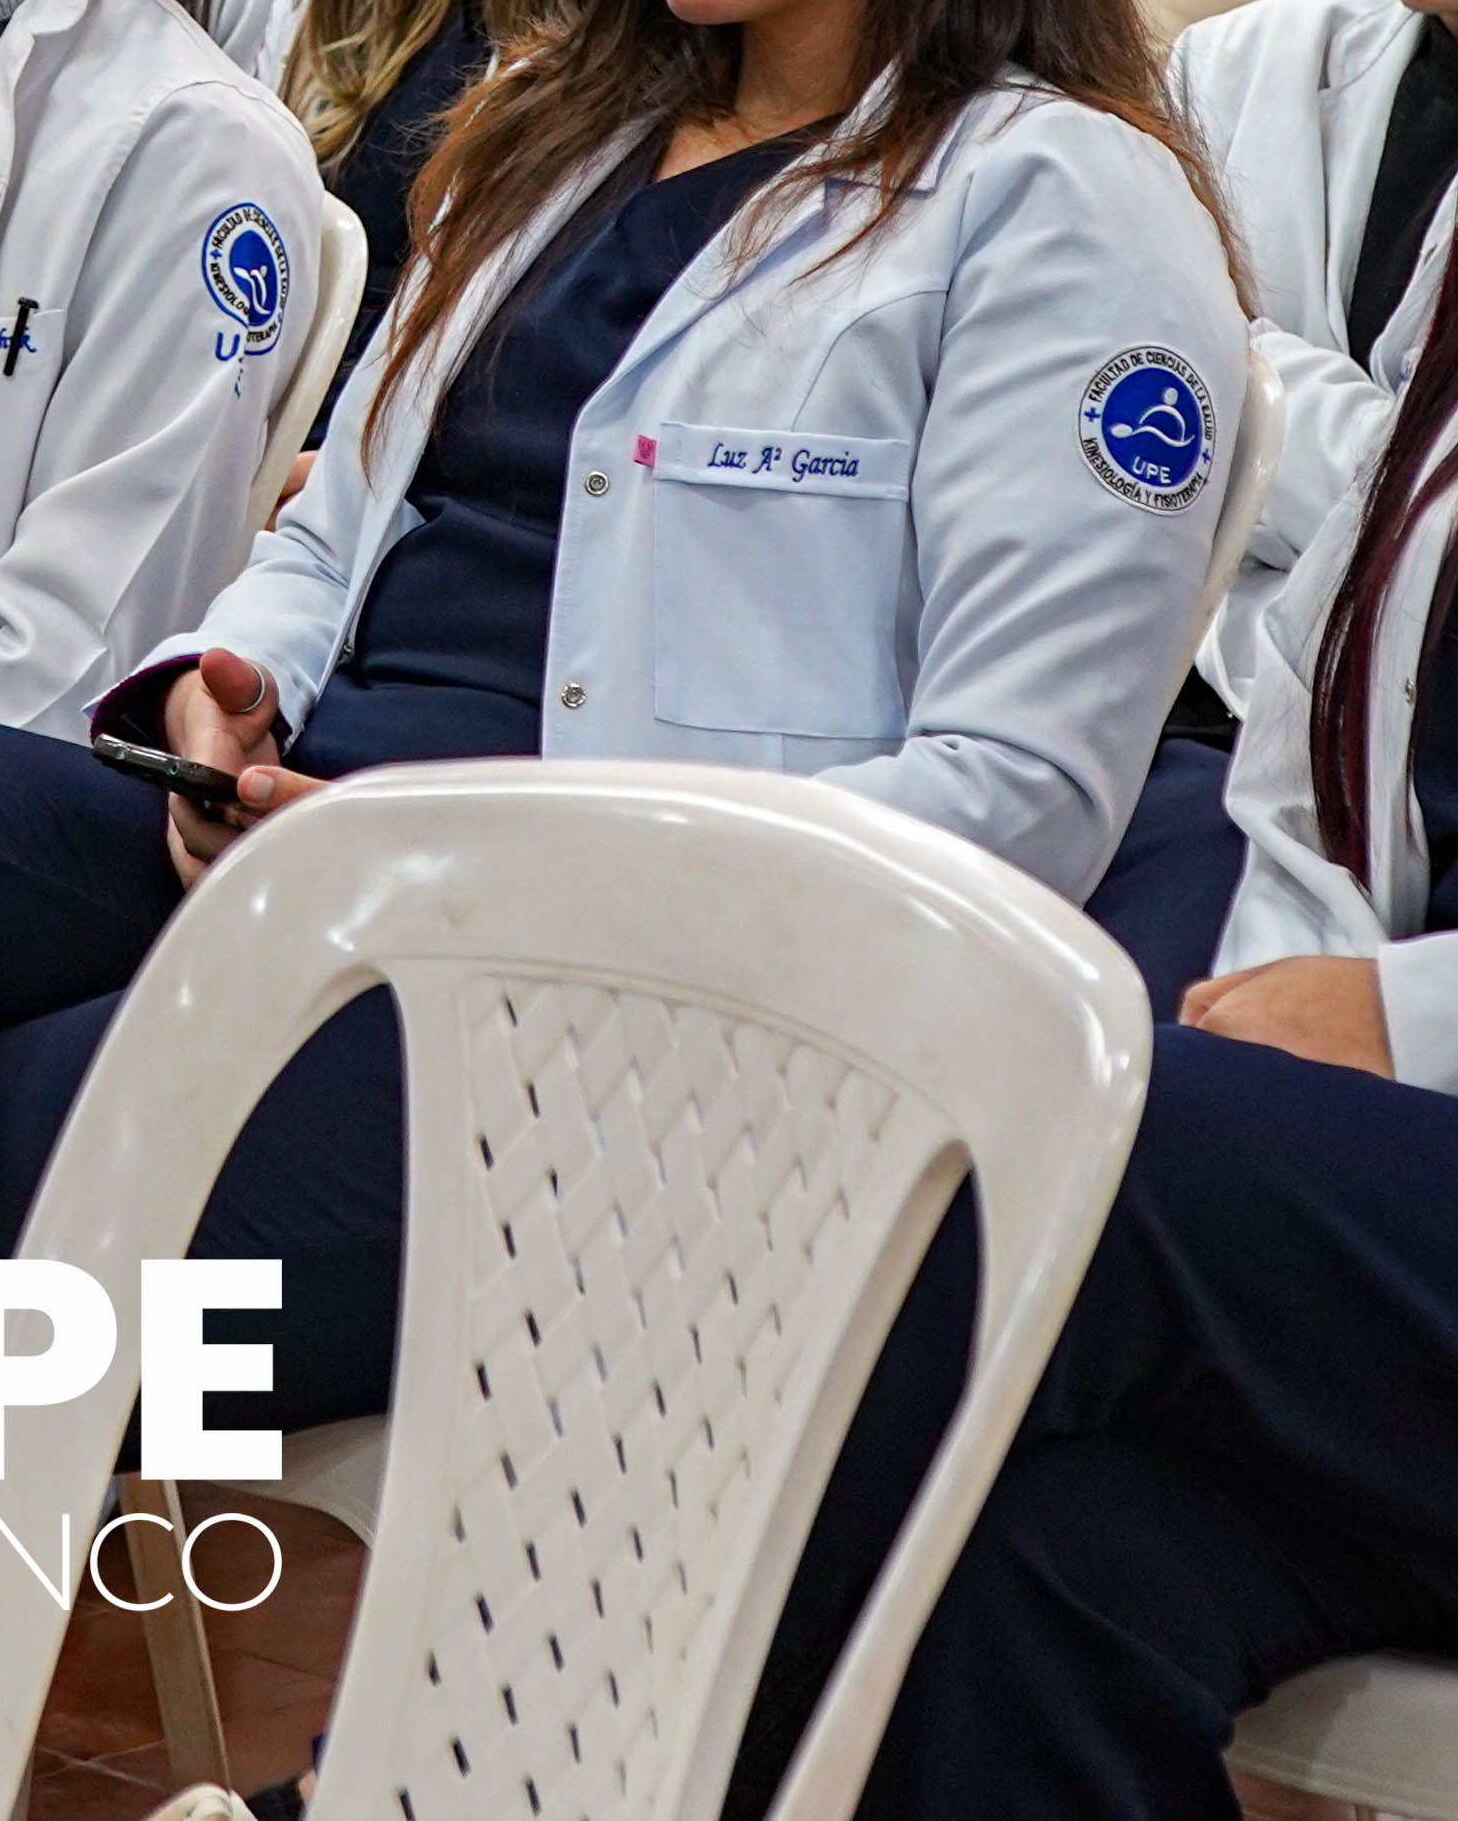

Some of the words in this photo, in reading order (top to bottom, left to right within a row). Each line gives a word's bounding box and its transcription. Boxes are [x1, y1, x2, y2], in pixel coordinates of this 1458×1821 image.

[1089, 358, 1130, 403] FACULTAD
[1130, 352, 1145, 366] DE
[1145, 351, 1187, 378] CIENCIAS
[708, 442, 748, 469] Luz
[1132, 456, 1172, 484] UPE
